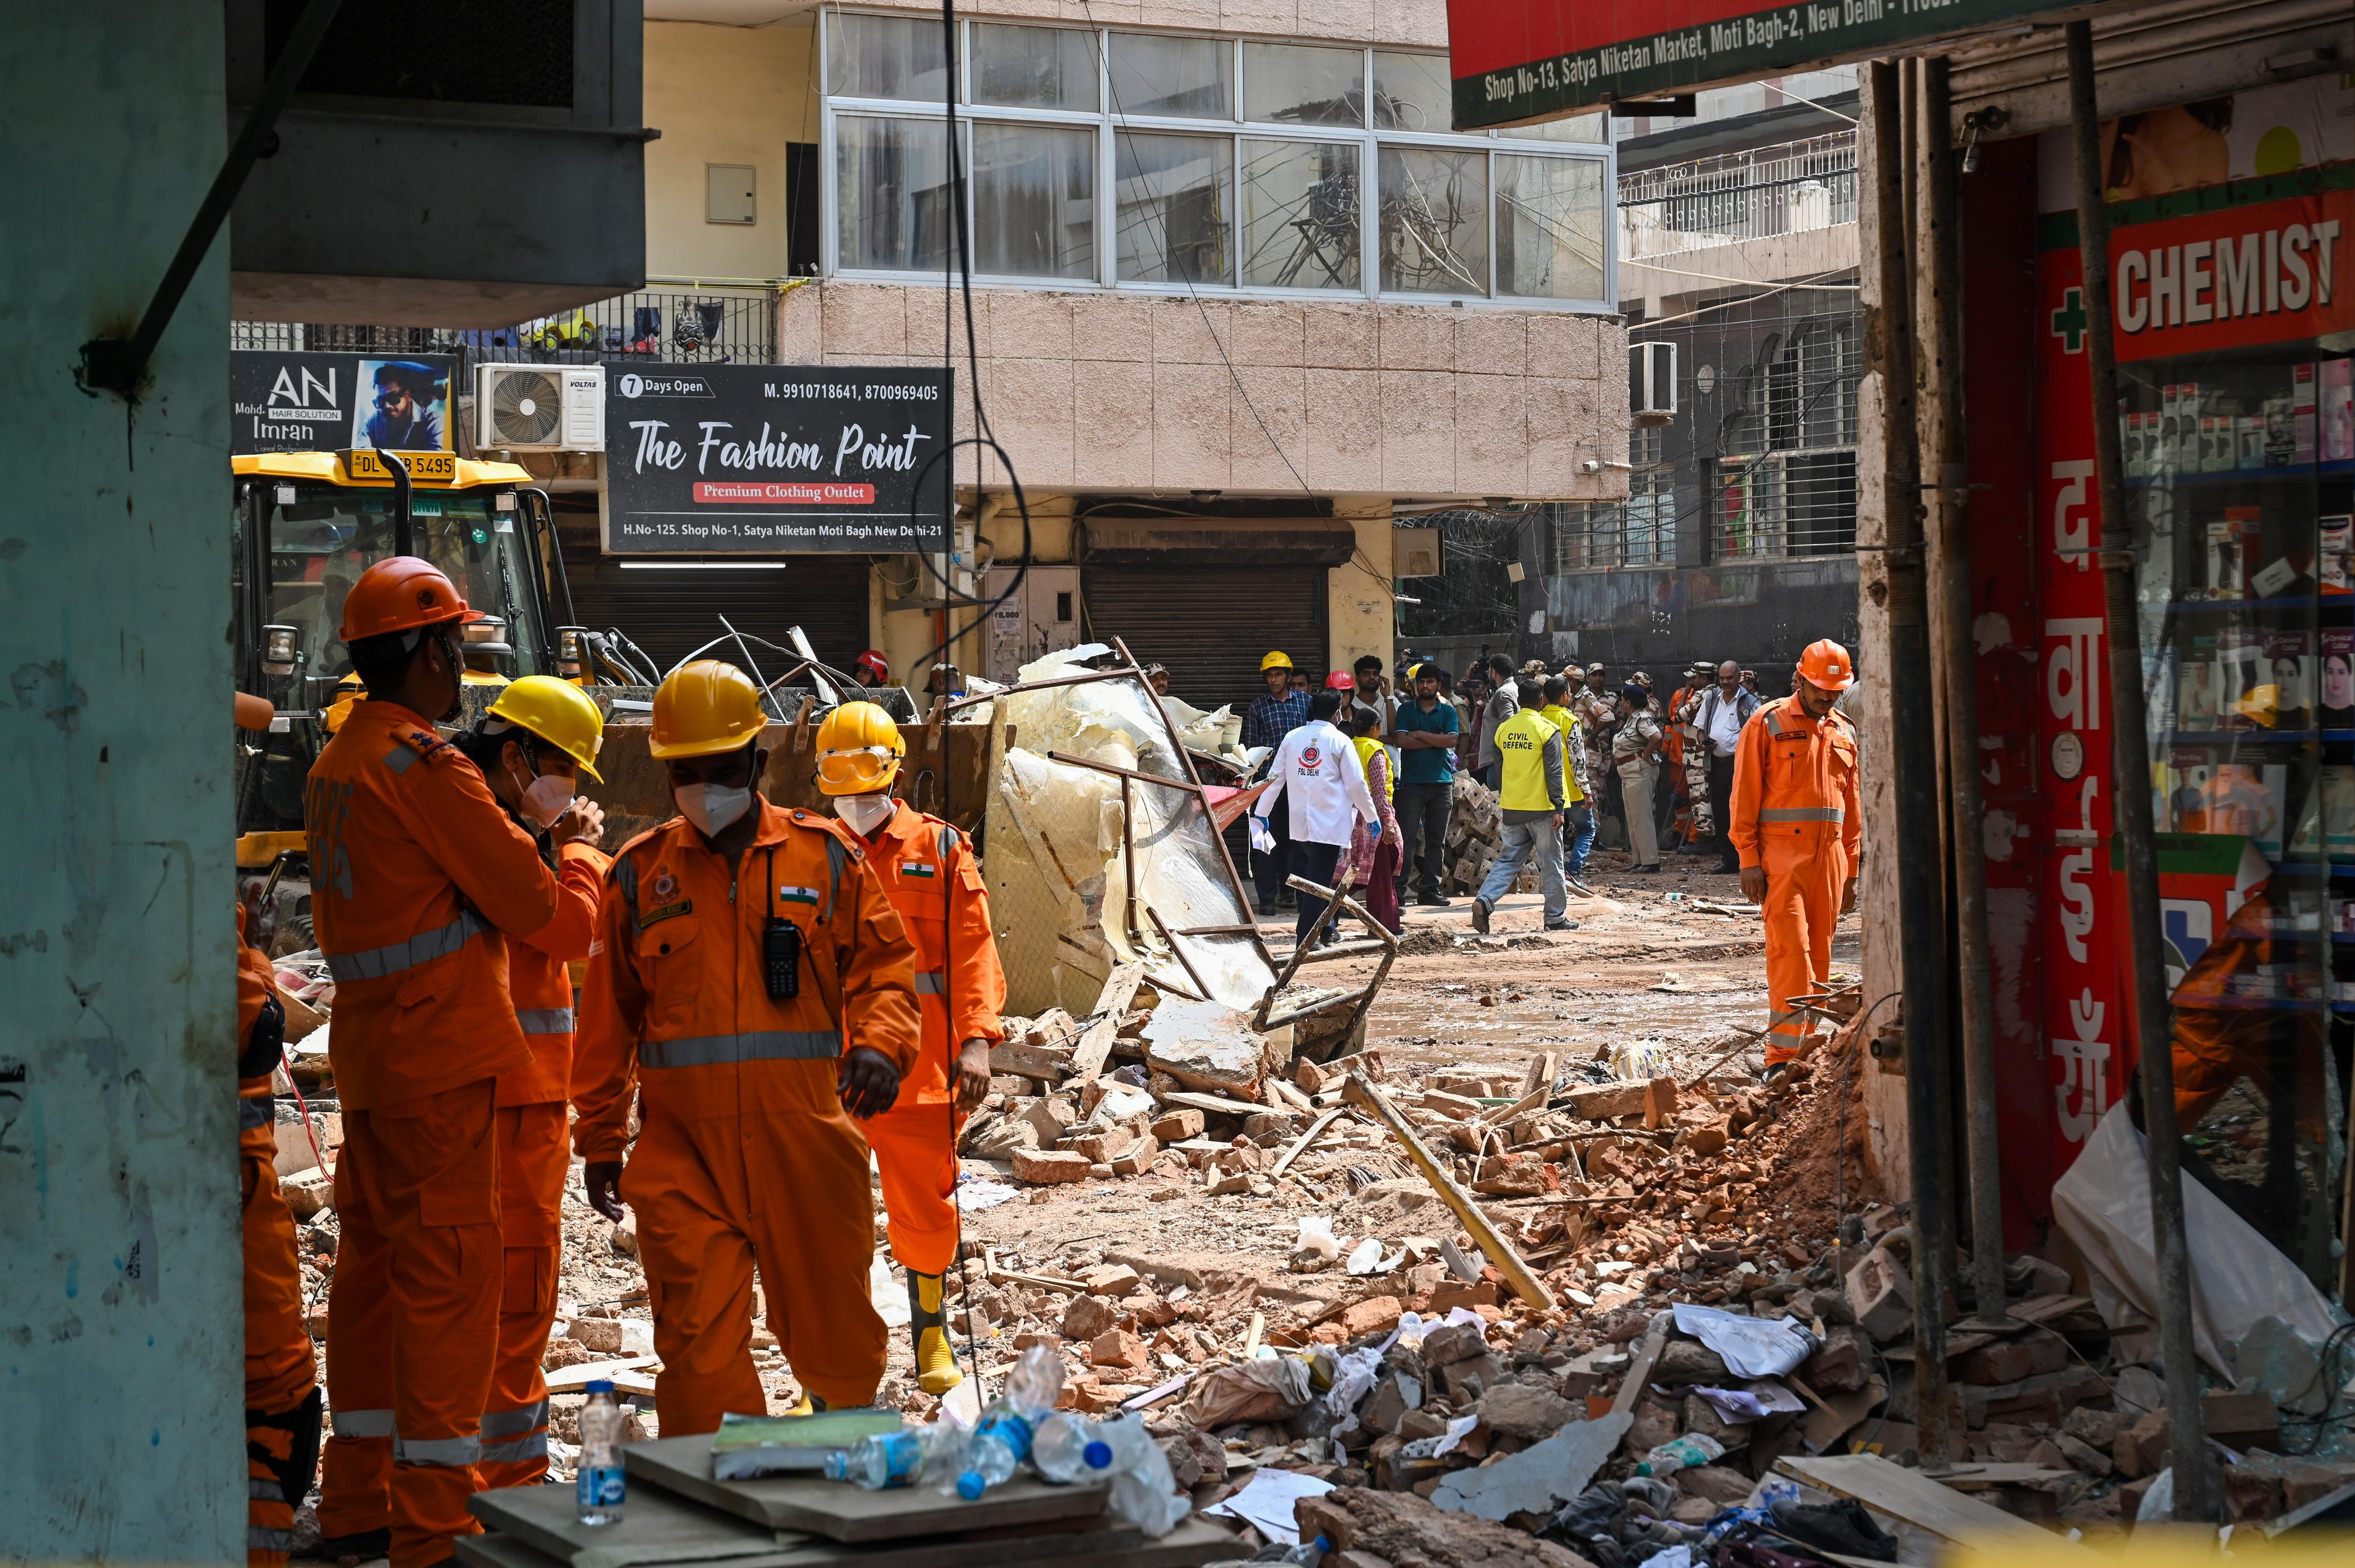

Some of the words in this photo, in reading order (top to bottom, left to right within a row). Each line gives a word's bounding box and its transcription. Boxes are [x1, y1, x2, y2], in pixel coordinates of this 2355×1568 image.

[1485, 71, 1515, 104] Shop
[1518, 64, 1559, 94] No-13,
[1562, 54, 1598, 86] Satya
[1600, 45, 1652, 77] Niketan
[1654, 33, 1707, 65] Market,
[1711, 25, 1742, 53] Moti
[1747, 15, 1805, 51] Bagh-2,
[1808, 7, 1840, 33] New
[2117, 220, 2340, 334] CHEMIST
[267, 365, 337, 408] AN
[627, 377, 636, 394] 7
[645, 380, 672, 393] Days
[674, 380, 703, 394] Open
[765, 383, 780, 397] M.
[783, 383, 862, 401] 9910718641,
[865, 384, 938, 400] 8700969405
[235, 402, 266, 415] Mohd.
[295, 410, 338, 419] SOLUTION
[253, 415, 313, 441] Imran
[629, 419, 687, 475] The
[698, 421, 823, 475] Fashion
[834, 423, 932, 476] Point
[363, 457, 380, 472] DL
[417, 458, 451, 473] 5495
[703, 484, 762, 498] Premium
[765, 485, 821, 501] Clothing
[824, 486, 864, 499] Outlet
[623, 524, 679, 535] H.No-125.
[681, 524, 709, 538] Shop
[711, 525, 741, 538] No-1,
[744, 524, 773, 538] Satya
[775, 525, 816, 536] Niketan
[819, 525, 843, 536] Moti
[846, 525, 872, 539] Bagh
[875, 526, 897, 536] New
[1307, 768, 1320, 777] DELHI
